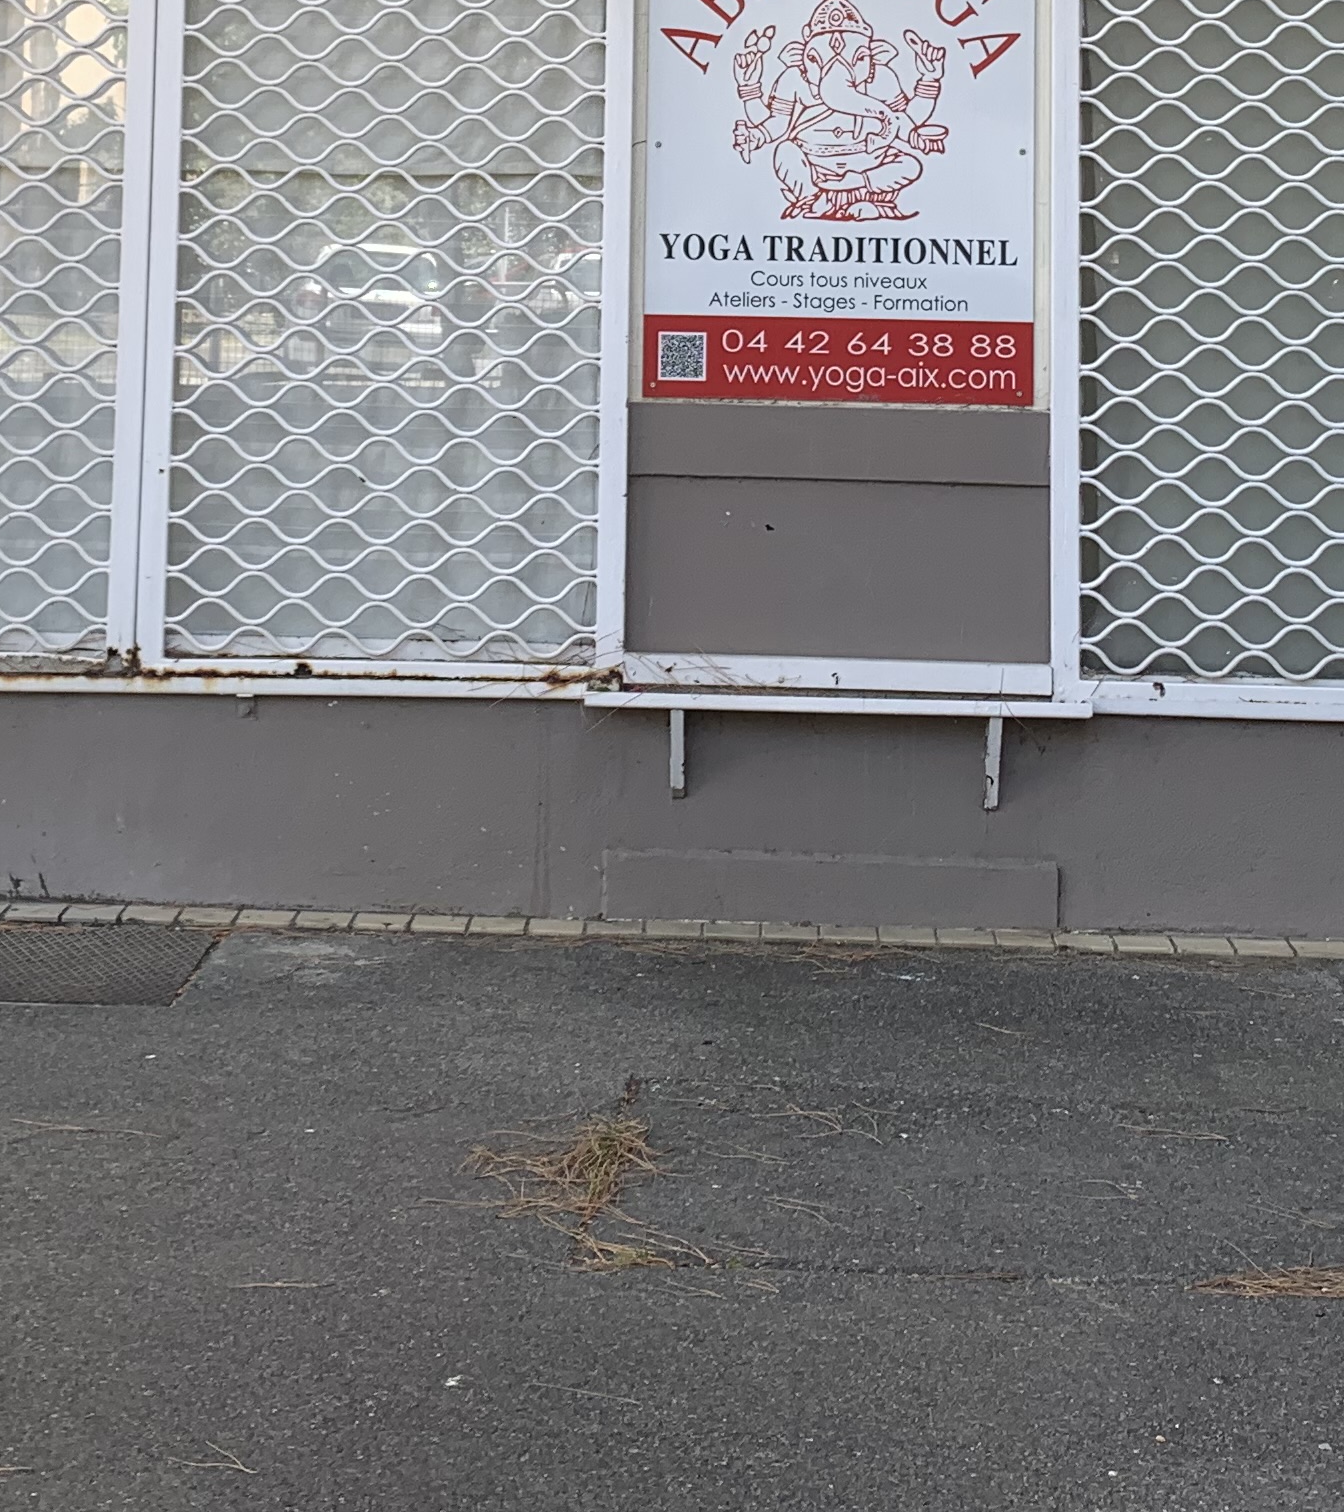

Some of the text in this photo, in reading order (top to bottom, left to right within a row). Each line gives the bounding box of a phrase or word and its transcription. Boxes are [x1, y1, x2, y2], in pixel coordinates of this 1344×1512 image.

[659, 232, 1019, 267] YOGA TRADITIONNEL
[750, 270, 928, 290] Cours tous niveaux
[709, 291, 776, 310] Ateliers
[793, 293, 856, 313] Stages
[873, 294, 969, 312] Formation
[721, 329, 1017, 359] 04 42 64 38 88
[722, 362, 1017, 393] www.yoga-aix.com
